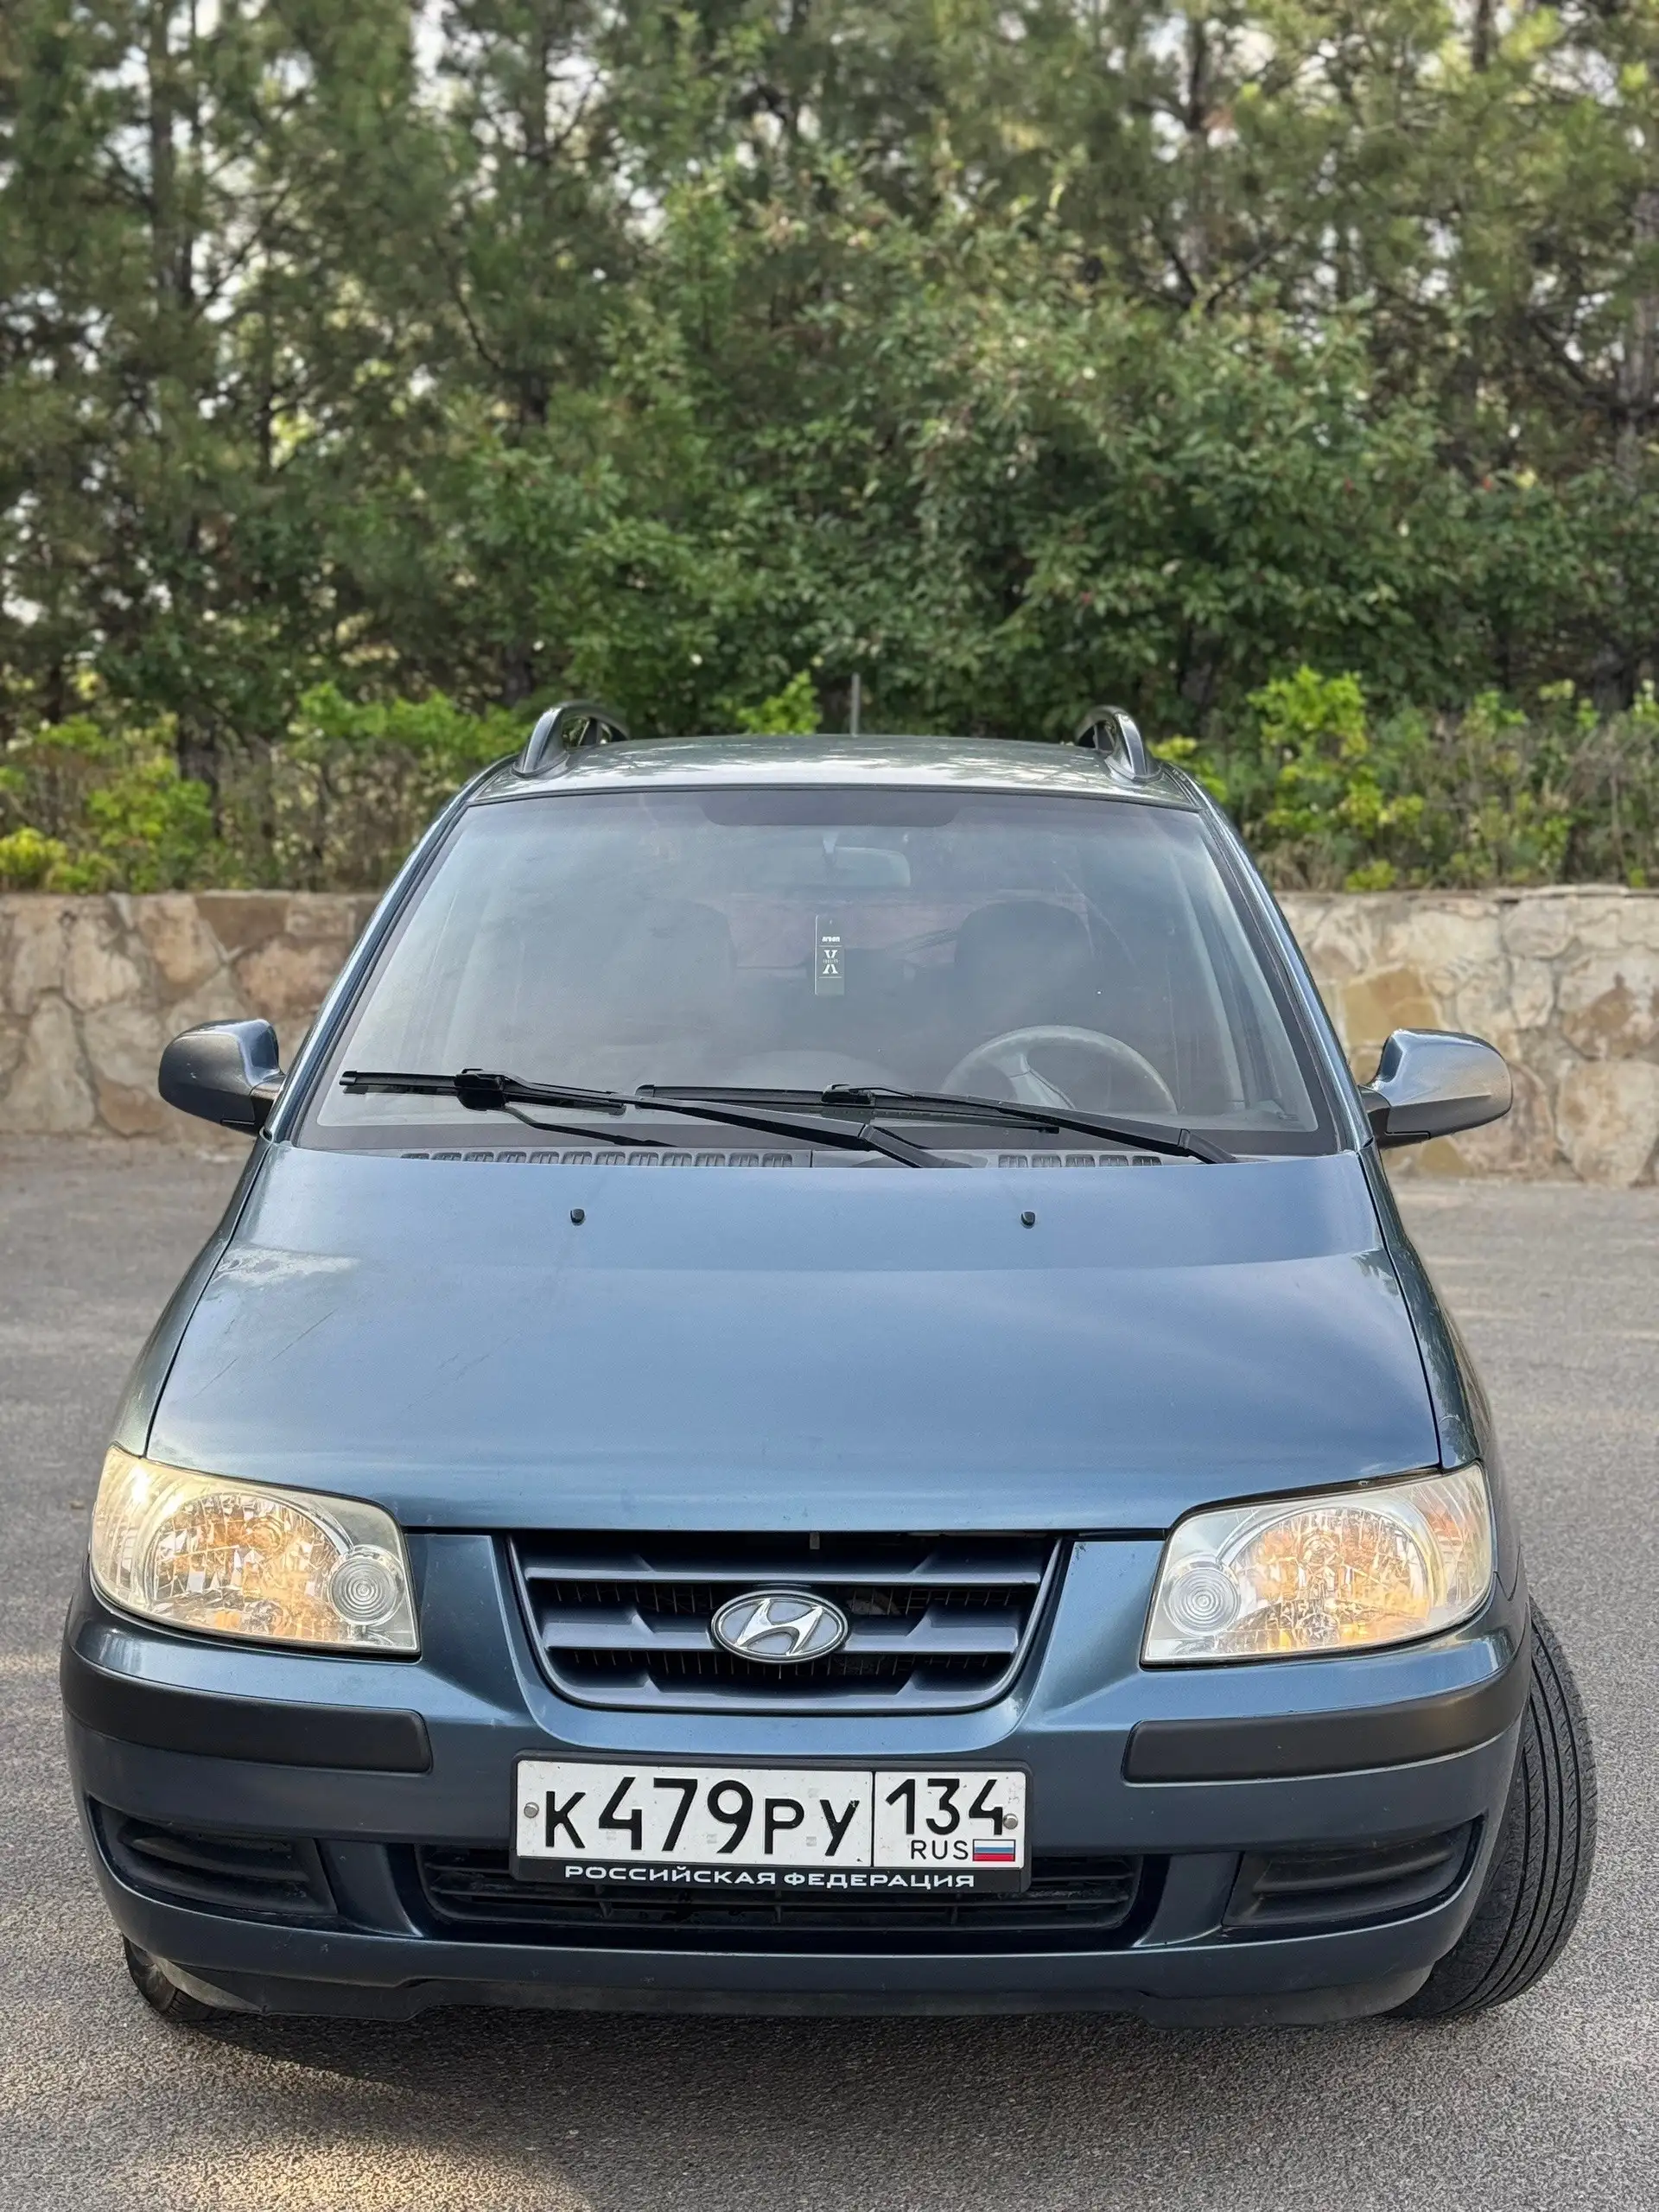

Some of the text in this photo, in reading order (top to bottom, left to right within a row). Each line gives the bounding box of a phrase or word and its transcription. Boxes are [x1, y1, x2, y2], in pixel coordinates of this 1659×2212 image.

[885, 1778, 1004, 1836] 134
[911, 1840, 969, 1860] RUS
[564, 1866, 975, 1891] РОССИЙСКАЯ ФЕДЕРАЦИЯ
